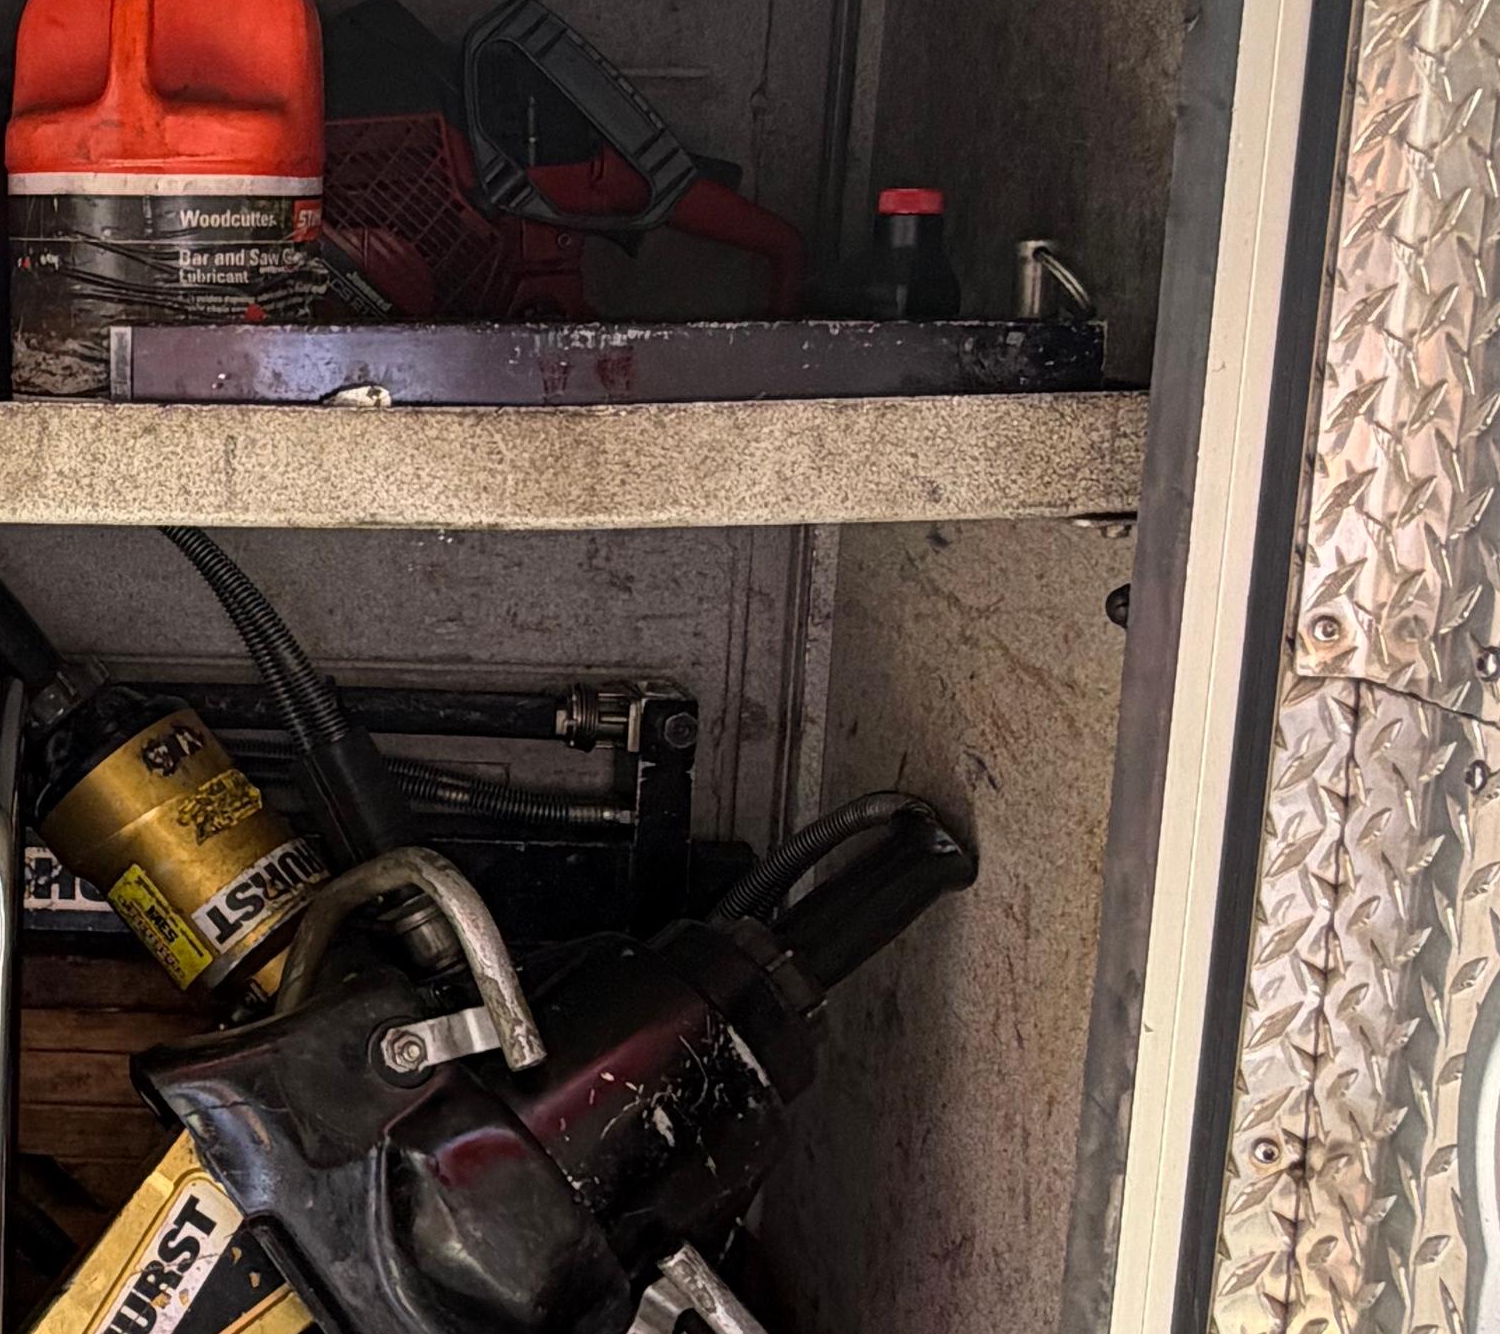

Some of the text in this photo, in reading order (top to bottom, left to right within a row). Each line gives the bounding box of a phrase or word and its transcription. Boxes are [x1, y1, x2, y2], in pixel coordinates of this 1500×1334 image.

[179, 249, 209, 266] Bar
[214, 249, 245, 266] and
[249, 249, 278, 266] Saw
[179, 269, 249, 284] Lubricant
[206, 842, 322, 945] HURST
